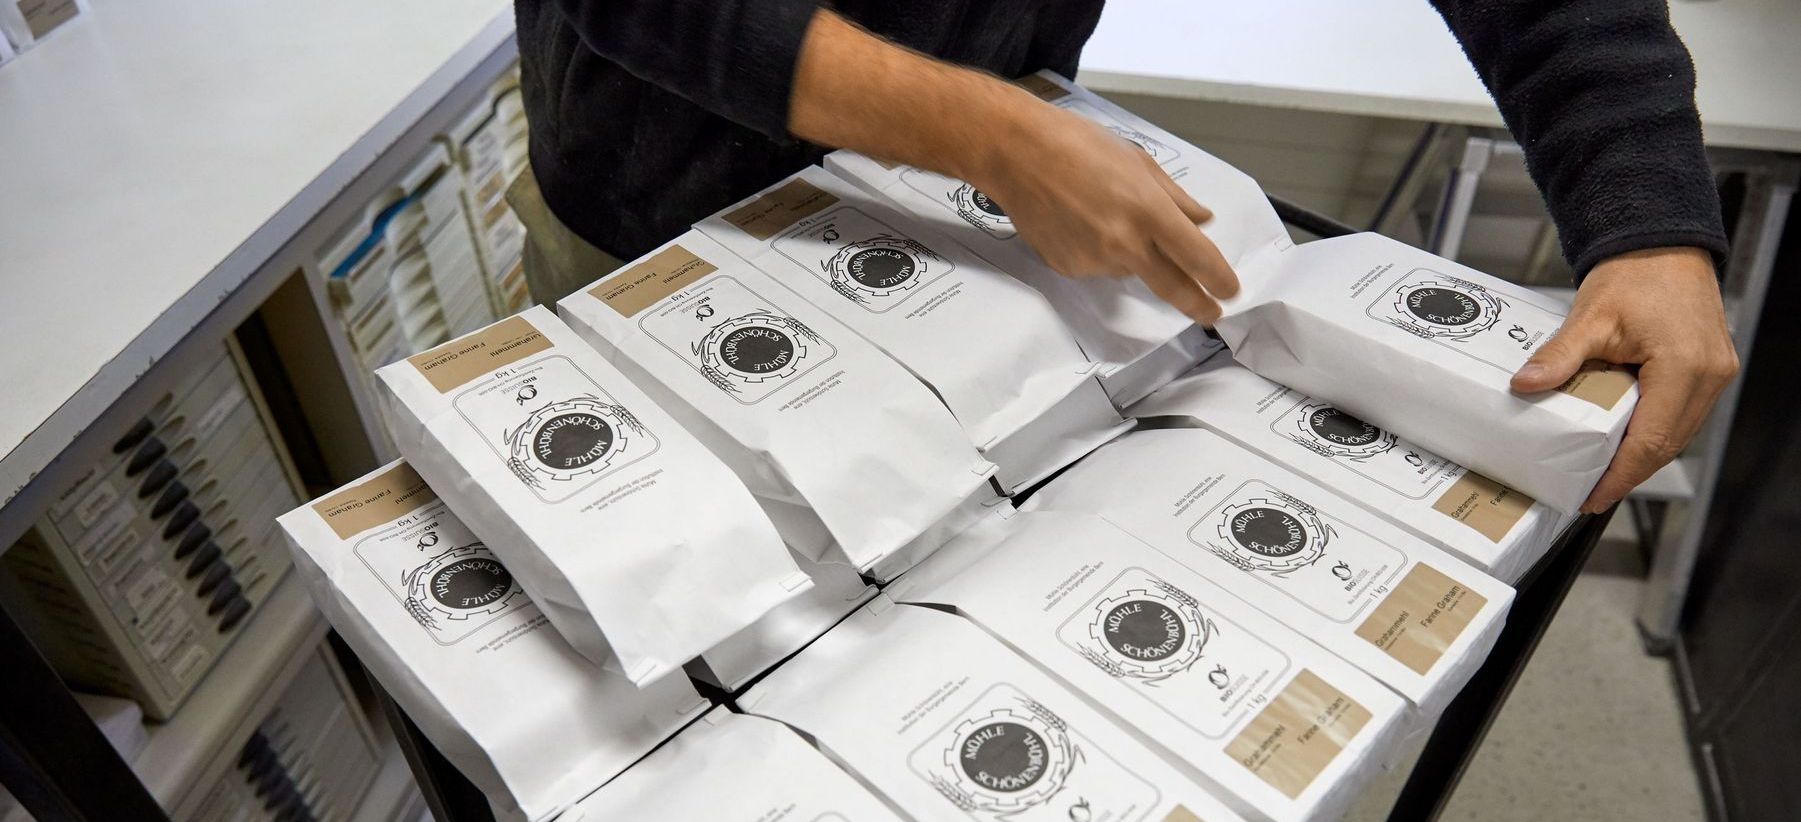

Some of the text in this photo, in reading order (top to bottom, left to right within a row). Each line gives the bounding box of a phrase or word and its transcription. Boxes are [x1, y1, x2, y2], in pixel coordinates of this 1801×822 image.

[852, 250, 904, 280] SCHÖNENBÜHL
[880, 265, 910, 286] MÜHLE
[606, 284, 635, 300] Graham
[671, 294, 684, 302] kg
[1412, 289, 1438, 308] MÜHLE
[1426, 293, 1475, 324] SCHÖNENBÜHL
[490, 333, 541, 358] Grahammehl
[726, 329, 782, 364] SCHÖNENBÜHL
[424, 355, 458, 370] Graham
[754, 350, 789, 371] MÜHLE
[495, 371, 510, 380] kg
[538, 416, 604, 459] SCHÖNENBÜHL
[565, 440, 608, 466] MÜHLE
[1446, 470, 1457, 480] kg
[328, 503, 364, 518] Graham
[398, 518, 412, 526] kg
[1236, 510, 1264, 534] MÜHLE
[1249, 516, 1302, 554] SCHÖNENBÜHL
[437, 561, 503, 598] SCHÖNENBÜHL
[1374, 584, 1388, 595] kg
[462, 584, 505, 606] MÜHLE
[1420, 608, 1440, 628] Farine
[1436, 586, 1461, 610] Graham
[1108, 603, 1142, 633] MÜHLE
[1375, 611, 1410, 648] Grahammehl
[1120, 609, 1180, 658] SCHÖNENBÜHL
[1252, 694, 1268, 705] kg
[965, 725, 1004, 760] MÜHLE
[975, 732, 1043, 789] SCHÖNENBÜHL
